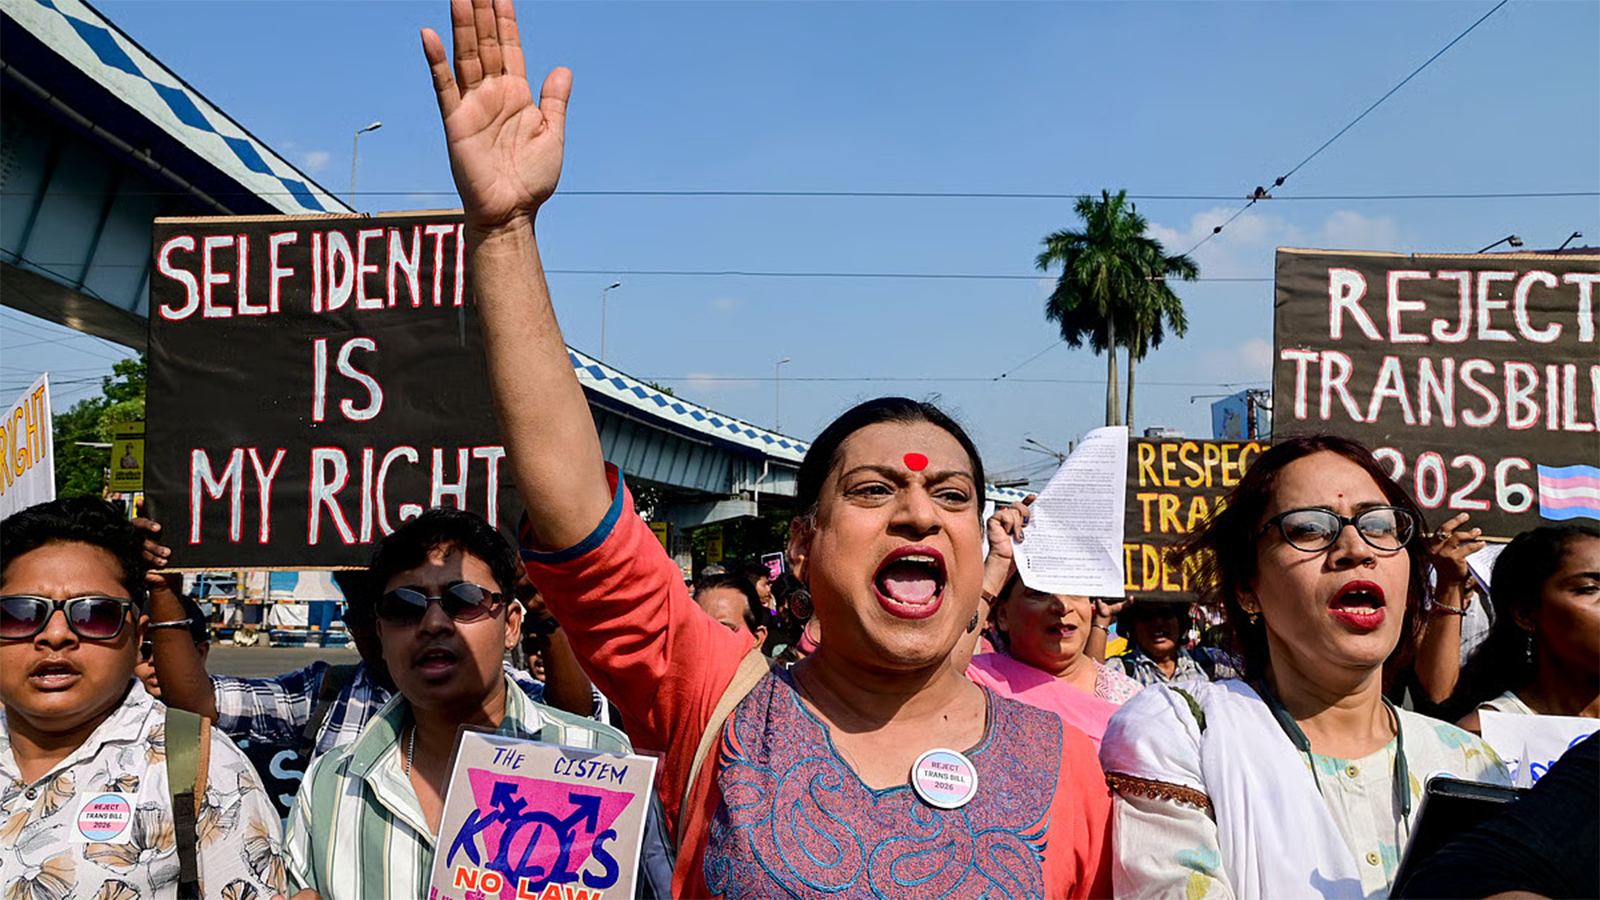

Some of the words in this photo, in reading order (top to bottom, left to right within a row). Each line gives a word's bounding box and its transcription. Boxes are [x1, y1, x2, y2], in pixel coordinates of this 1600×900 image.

[157, 231, 298, 321] SELF
[311, 222, 477, 314] IDENTI
[1328, 267, 1600, 344] REJECT
[311, 337, 385, 423] IS
[1280, 347, 1600, 432] TRANSBIL
[0, 384, 46, 496] RIGHT
[1137, 441, 1272, 488] RESPEC
[189, 446, 287, 545] MY
[308, 445, 506, 546] RIGHT
[1124, 543, 1219, 592] IDEN
[492, 746, 527, 770] THE
[553, 757, 629, 785] CISTEM
[924, 769, 949, 781] TRANS
[950, 774, 966, 783] BILL
[931, 761, 959, 772] REJECT
[934, 781, 954, 791] 2026
[86, 812, 108, 820] TRANS
[108, 812, 123, 820] BILL
[93, 821, 111, 829] 2026
[453, 864, 503, 895] NO
